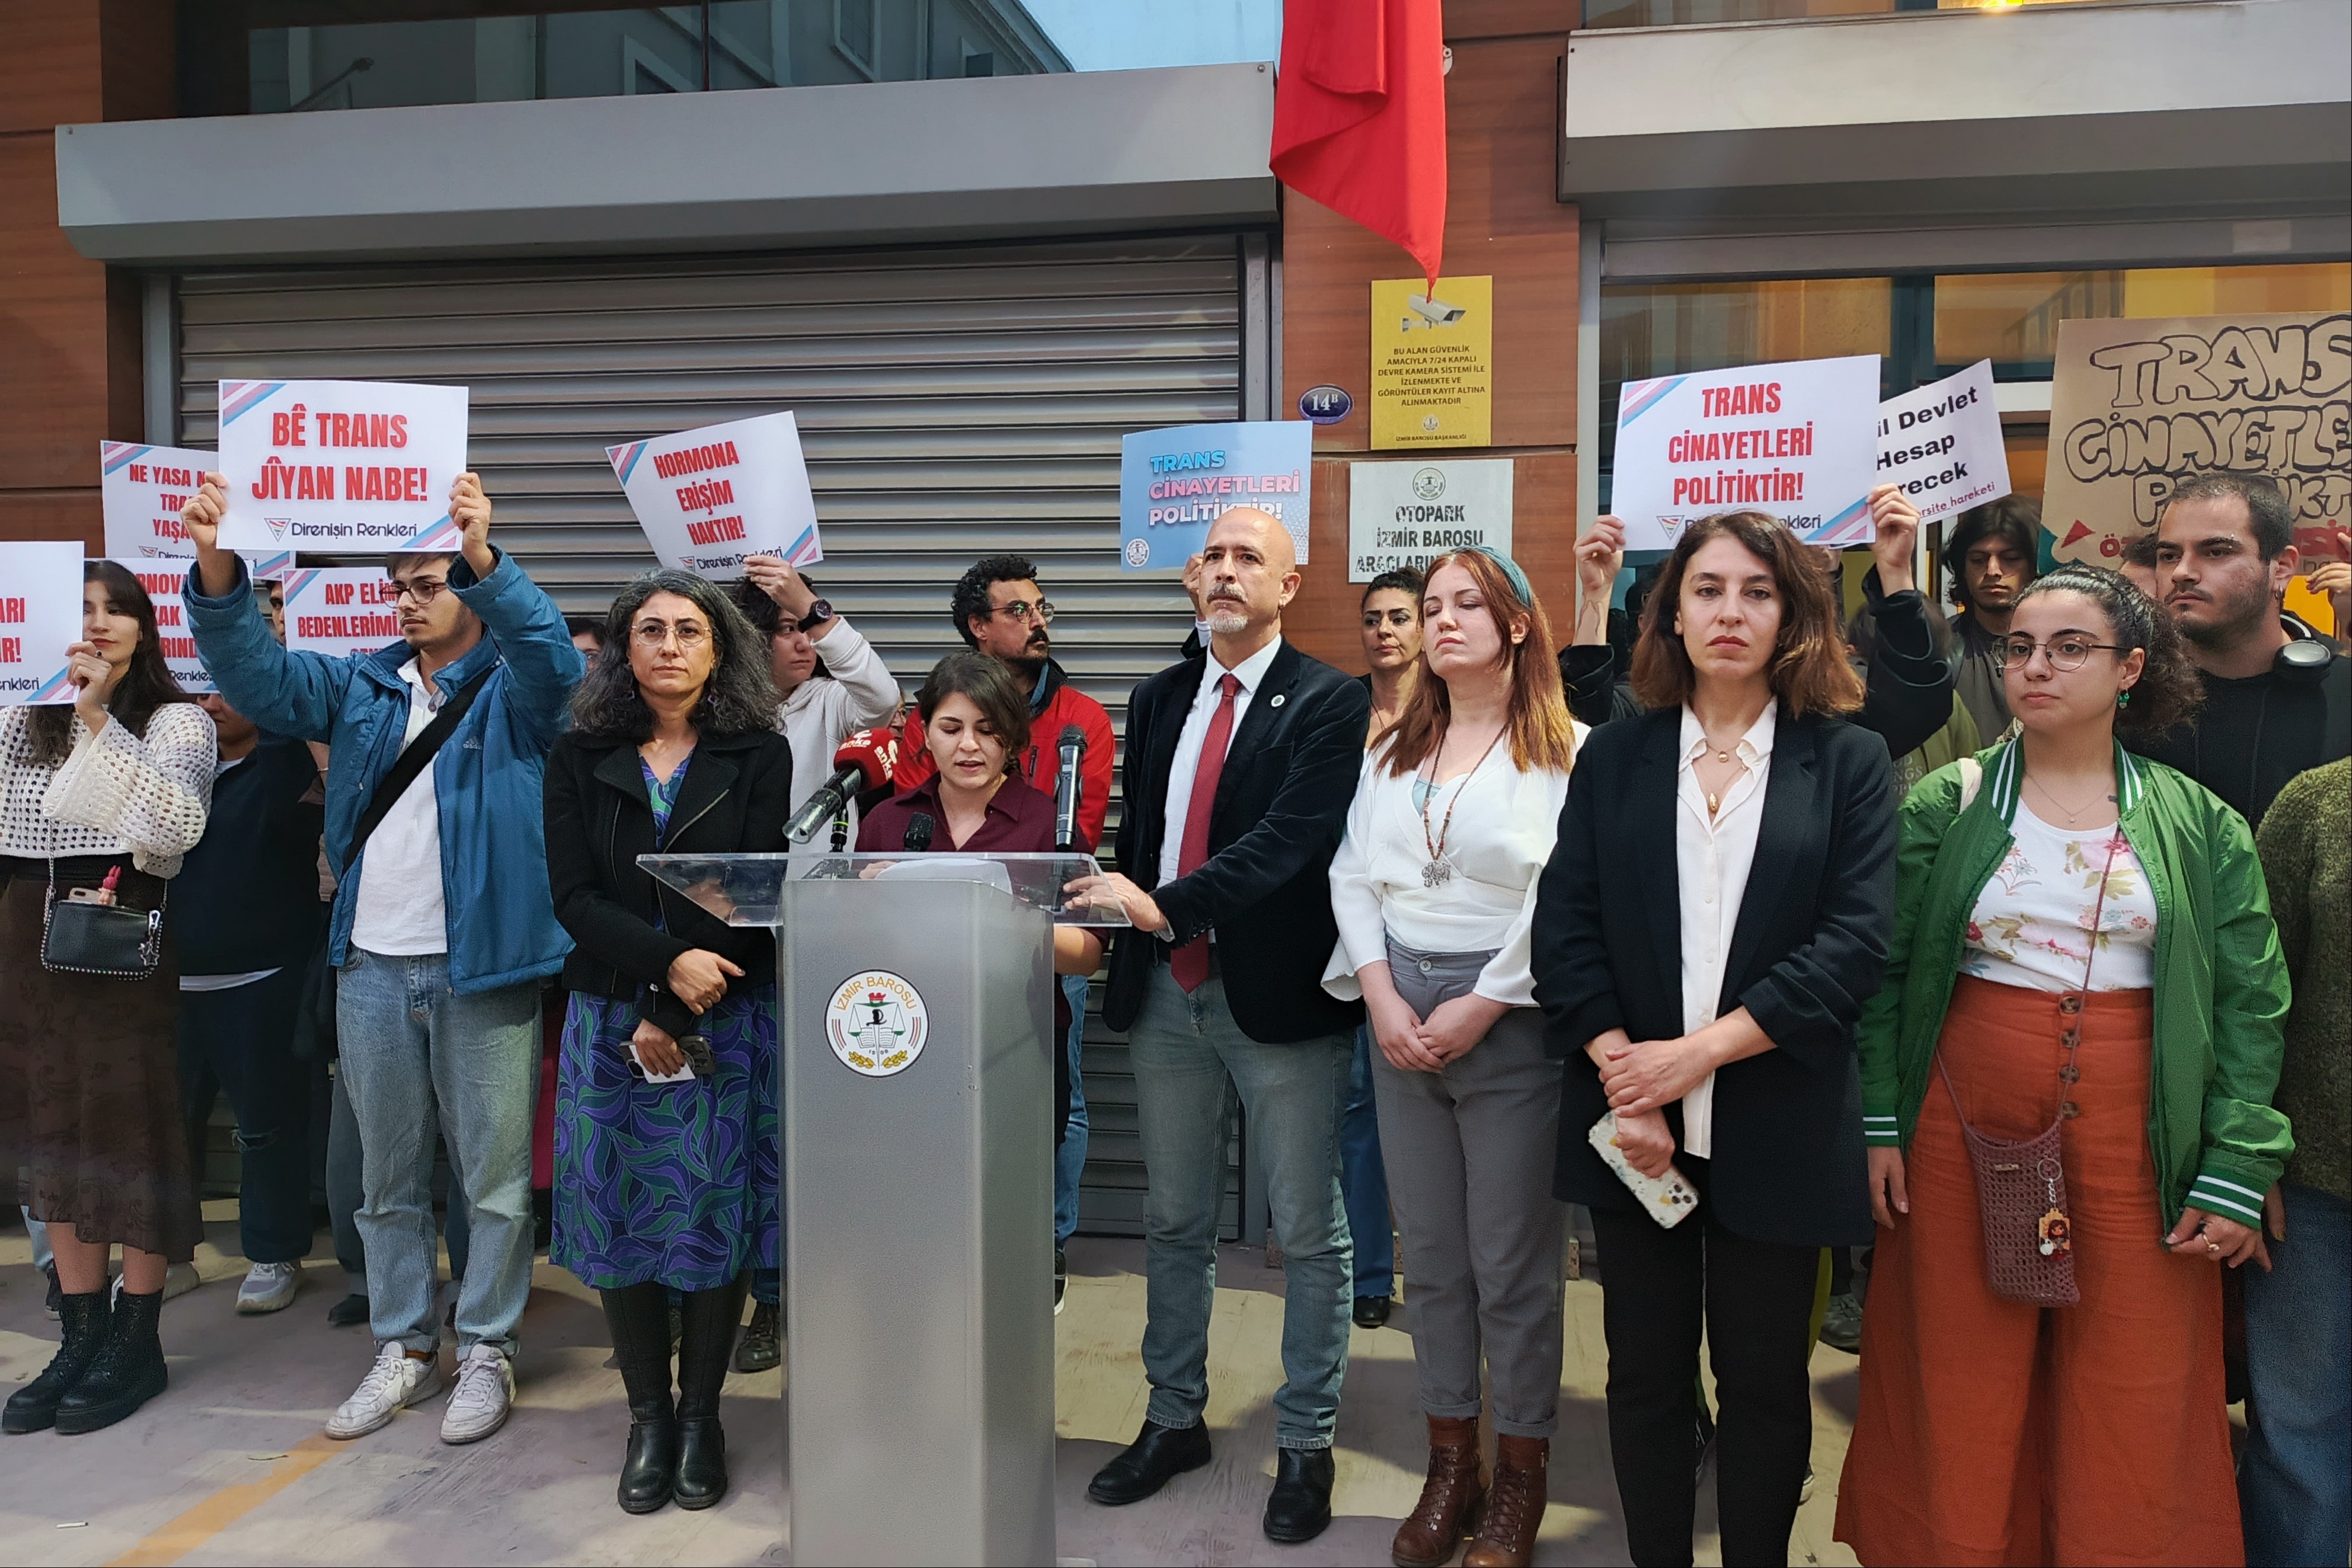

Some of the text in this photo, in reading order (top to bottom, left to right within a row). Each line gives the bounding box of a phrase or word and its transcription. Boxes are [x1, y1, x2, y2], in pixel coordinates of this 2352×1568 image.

[1430, 344, 1470, 353] GÜVENLİK
[1401, 377, 1450, 386] İZLENMEKTE
[1441, 365, 1472, 373] SİSTEMİ
[1378, 388, 1431, 396] GÖRÜNTÜLER
[1401, 398, 1461, 406] ALINMAKTADIR
[1702, 383, 1781, 418] TRANS
[1899, 386, 1978, 430] Devlet
[273, 403, 408, 449] BÊ TRANS
[1669, 421, 1813, 463] CİNAYETLERİ
[1877, 435, 1955, 471] Hesap
[653, 441, 740, 479] HORMONA
[1150, 450, 1225, 473] TRANS
[129, 463, 148, 483] NE
[152, 466, 191, 487] YASA
[252, 456, 428, 501] JÎYAN NABE!
[1149, 469, 1300, 499] CİNAYETLERİ
[1673, 467, 1803, 505] POLİTİKTİR!
[1897, 461, 1968, 495] recek
[160, 493, 194, 512] TRA
[676, 478, 734, 515] ERİŞİM
[1950, 482, 1995, 507] hareketi
[1396, 505, 1465, 522] OTOPARK
[152, 519, 191, 544] YAŞA
[292, 523, 417, 539] Direnişin Renkleri
[686, 516, 746, 545] HAKTIR!
[1377, 527, 1483, 548] İZMİR BAROSU
[696, 555, 737, 569] Direnişin
[325, 584, 354, 604] AKP
[0, 677, 39, 690] nkleri
[834, 976, 918, 1011] İZMİR BAROSU
